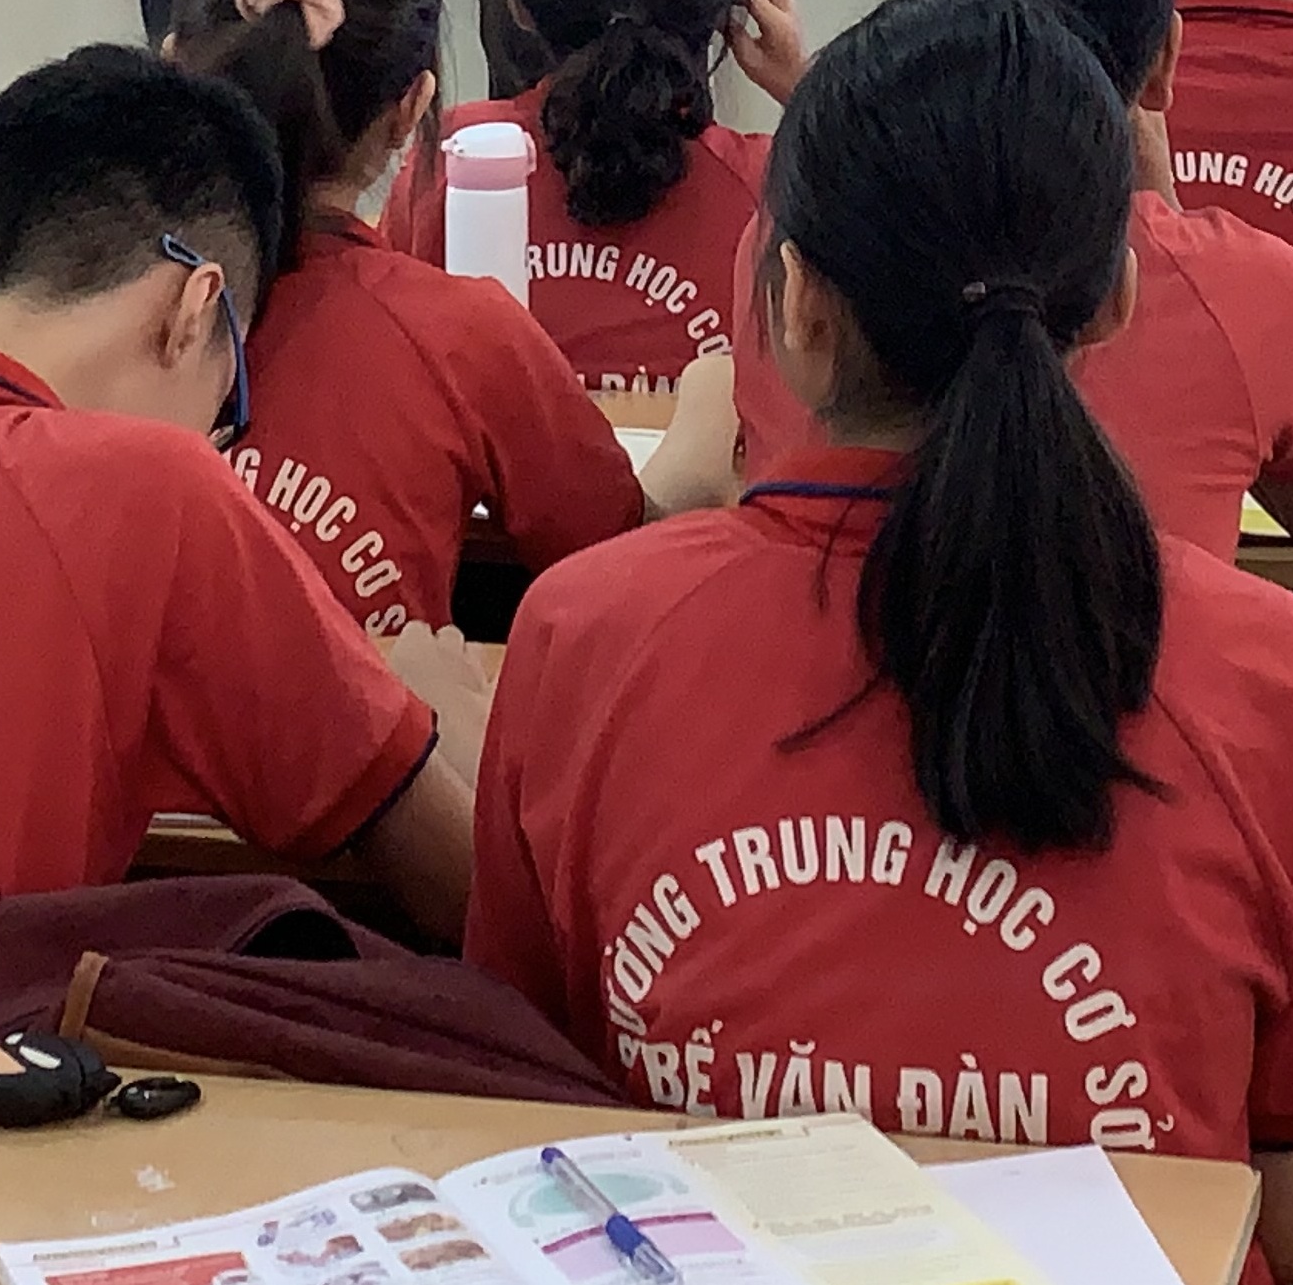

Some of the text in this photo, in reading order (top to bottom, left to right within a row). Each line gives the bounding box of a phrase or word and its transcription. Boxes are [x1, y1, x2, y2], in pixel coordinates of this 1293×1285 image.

[1173, 151, 1249, 186] UNG
[526, 243, 619, 283] RUNG
[626, 254, 697, 313] HỌC
[266, 458, 408, 637] HỌC CƠ S
[696, 816, 912, 906] TRUNG
[925, 838, 1054, 950] HỌC
[1043, 944, 1136, 1041] CƠ
[642, 1020, 1047, 1146] BẾ VĂN ĐÀN
